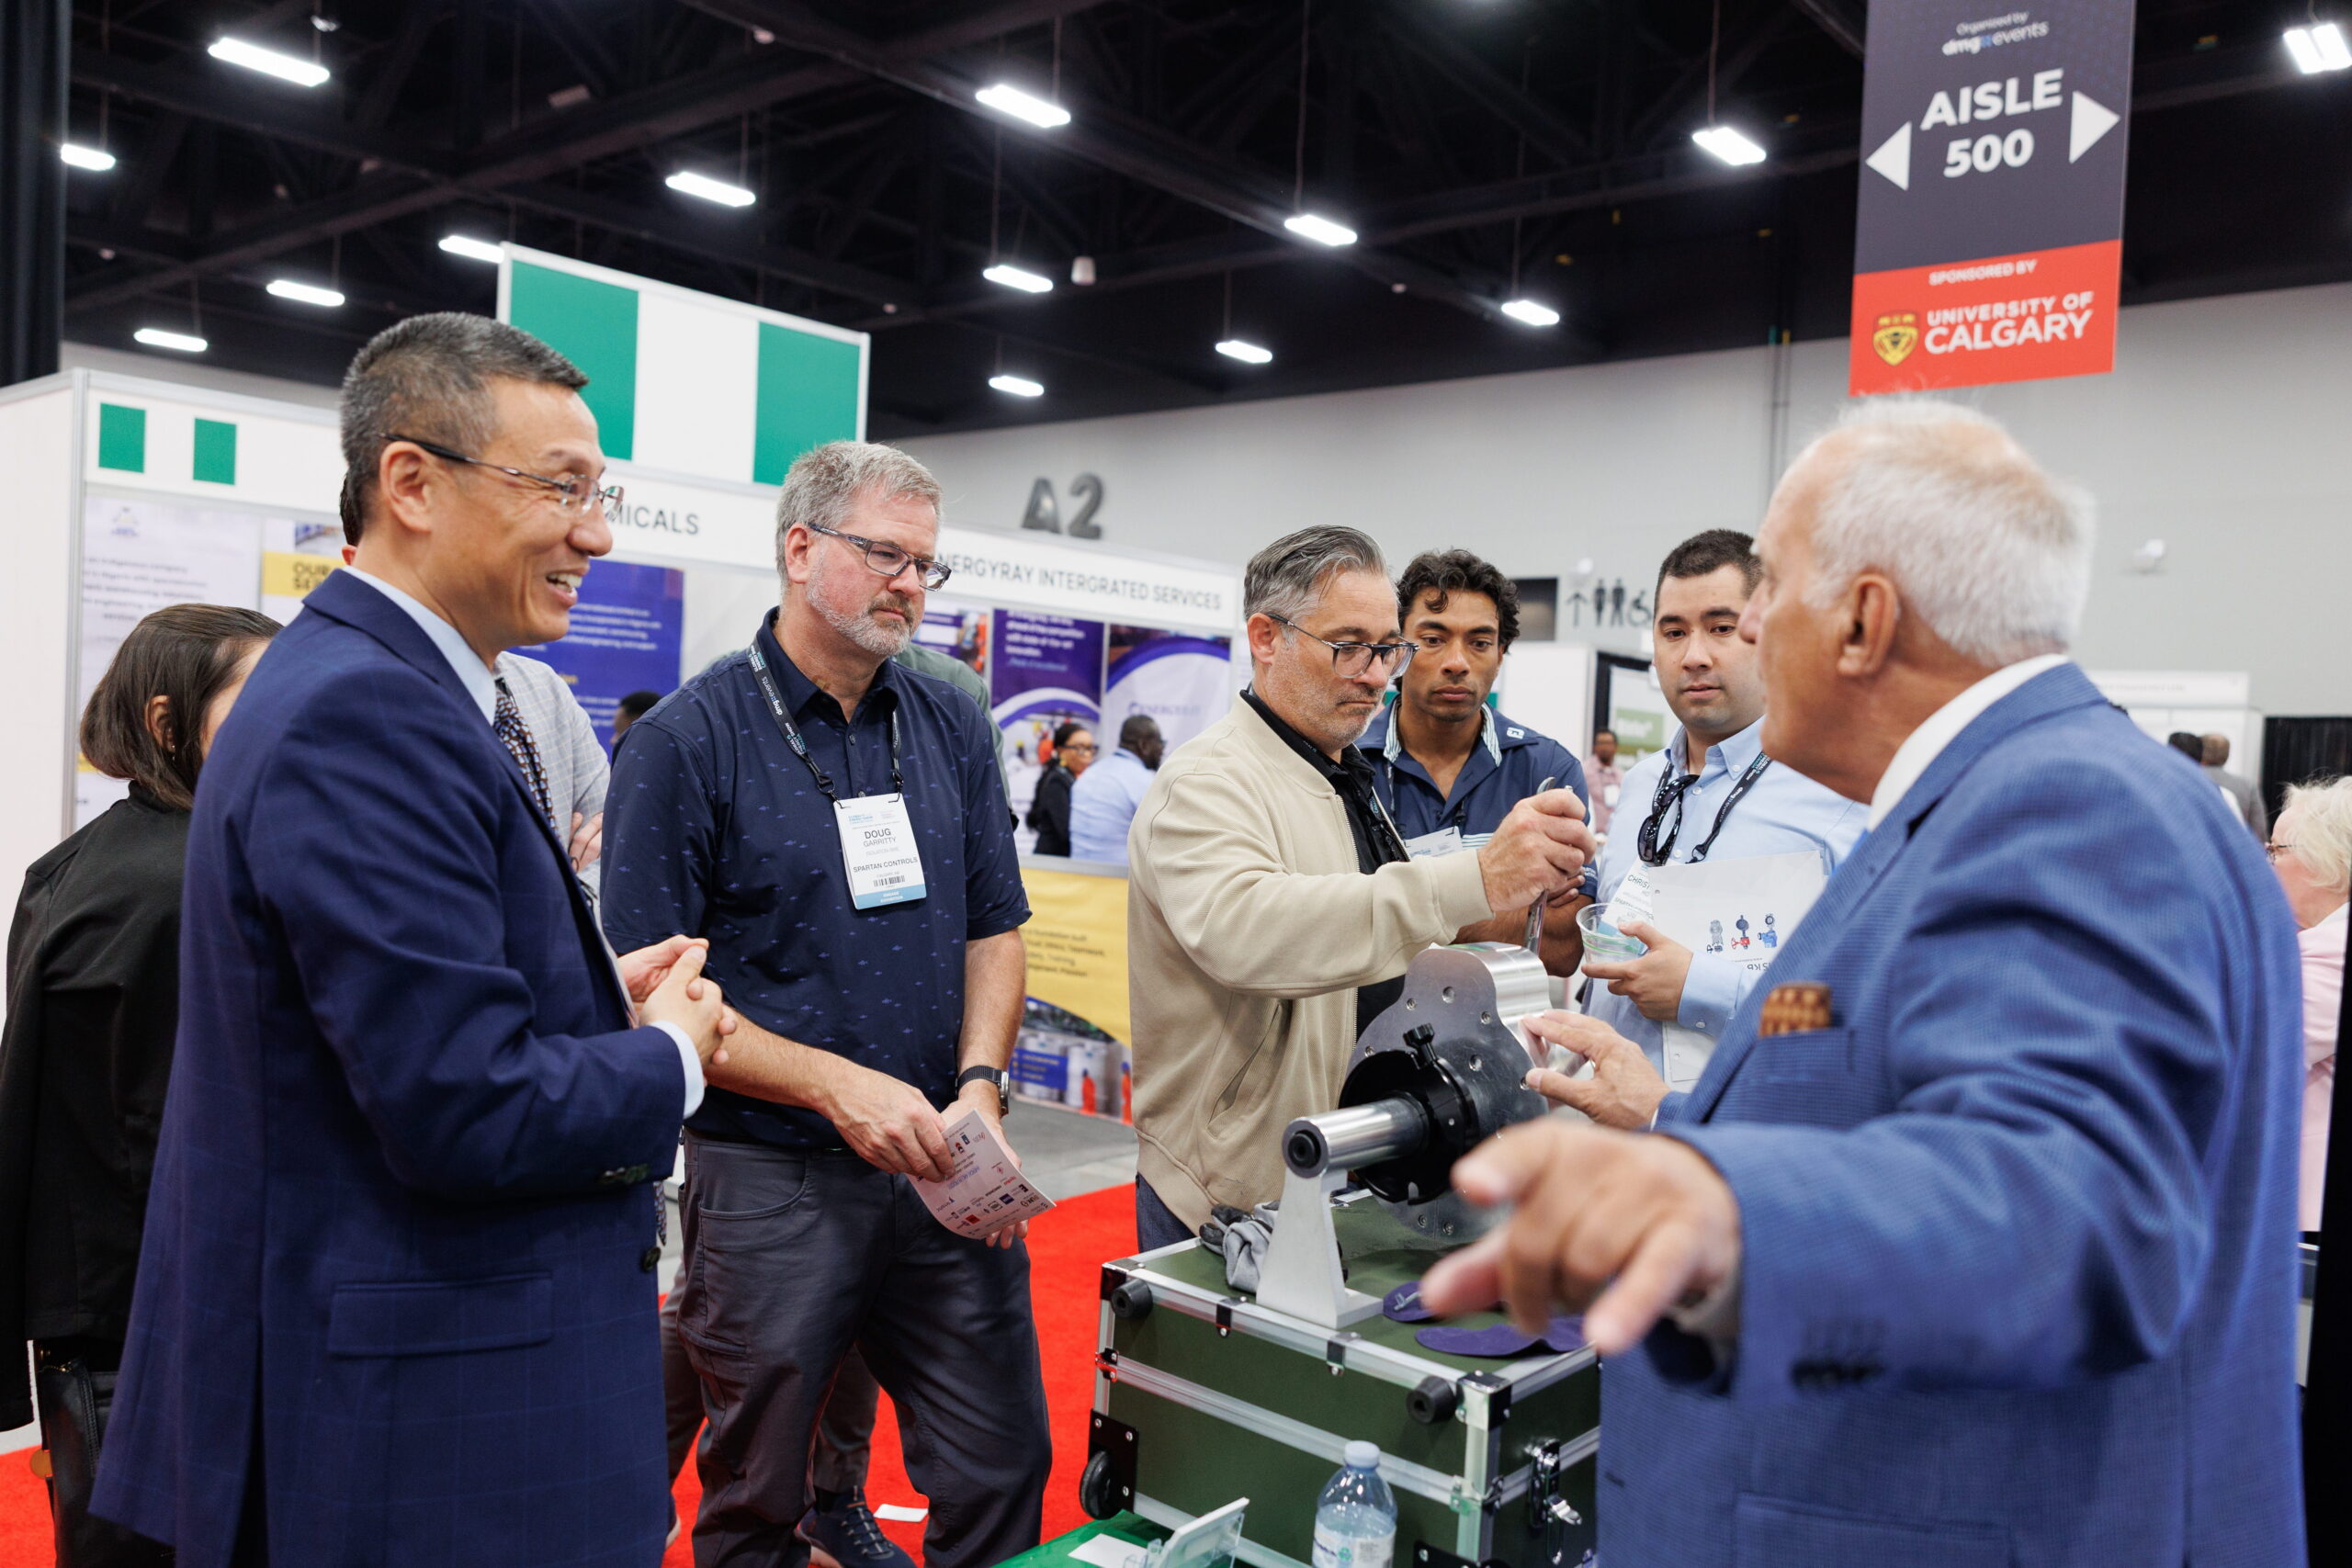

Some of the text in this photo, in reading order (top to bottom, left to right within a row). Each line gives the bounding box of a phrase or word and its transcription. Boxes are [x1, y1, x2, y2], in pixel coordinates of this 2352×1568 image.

[1956, 11, 2030, 35] Organized by
[1920, 68, 2064, 131] AISLE
[1943, 129, 2035, 178] 500
[1928, 259, 2038, 286] SPONSORED BY
[1928, 291, 2094, 327] UNIVERSITY OF
[1924, 309, 2094, 355] CALGARY
[1021, 472, 1105, 540] A2
[1039, 568, 1148, 600] INTERGRATED
[1153, 584, 1221, 610] SERVICES
[864, 837, 897, 847] GARRITTY
[865, 829, 891, 840] DOUG
[853, 857, 918, 874] SPARTAN CONTROLS
